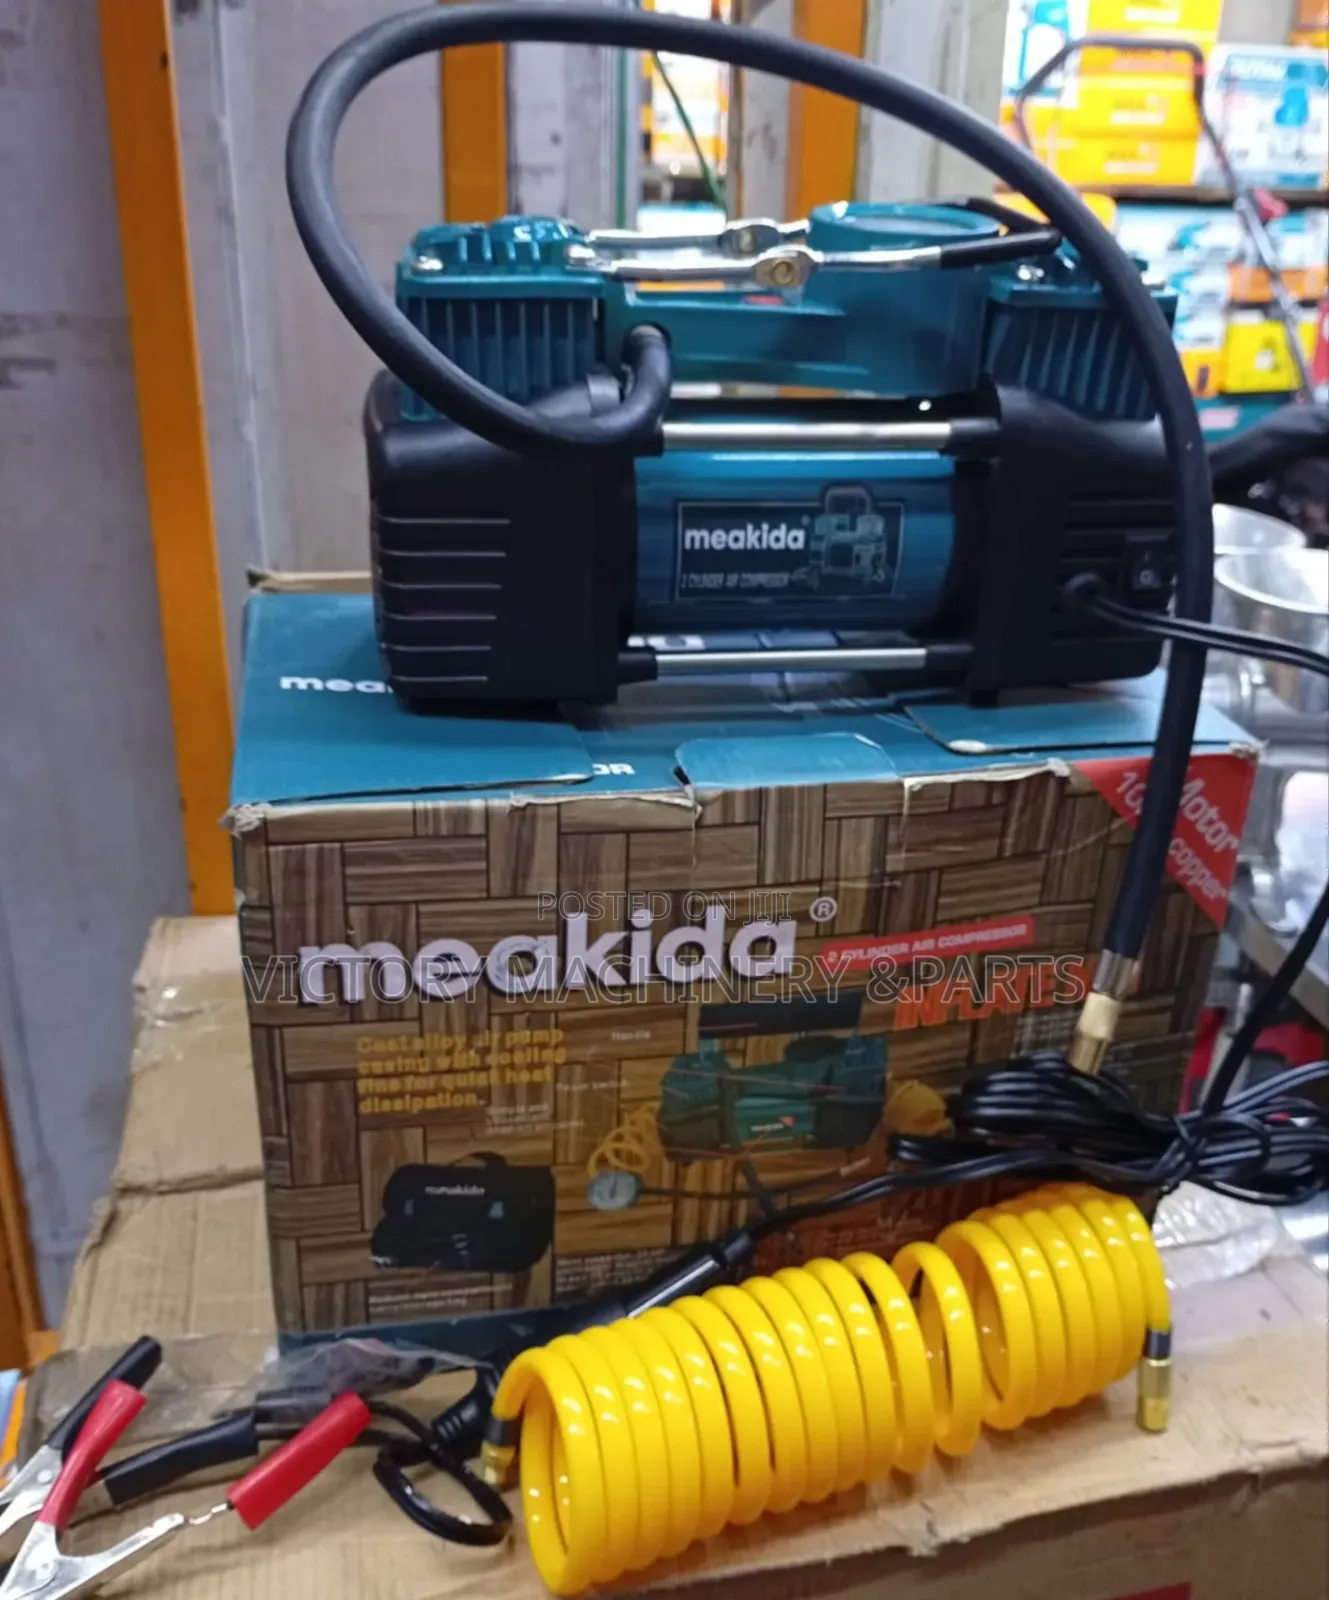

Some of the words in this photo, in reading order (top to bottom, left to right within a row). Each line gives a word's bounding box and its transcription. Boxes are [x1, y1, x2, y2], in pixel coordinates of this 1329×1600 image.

[684, 521, 806, 550] meakida
[280, 676, 394, 693] mea
[592, 763, 636, 775] OR
[912, 938, 935, 952] AIR
[938, 924, 1027, 948] COMPRESSOR
[299, 903, 797, 1005] meakida
[358, 1035, 408, 1053] Cast
[505, 1029, 564, 1047] pump
[505, 1066, 551, 1084] heat
